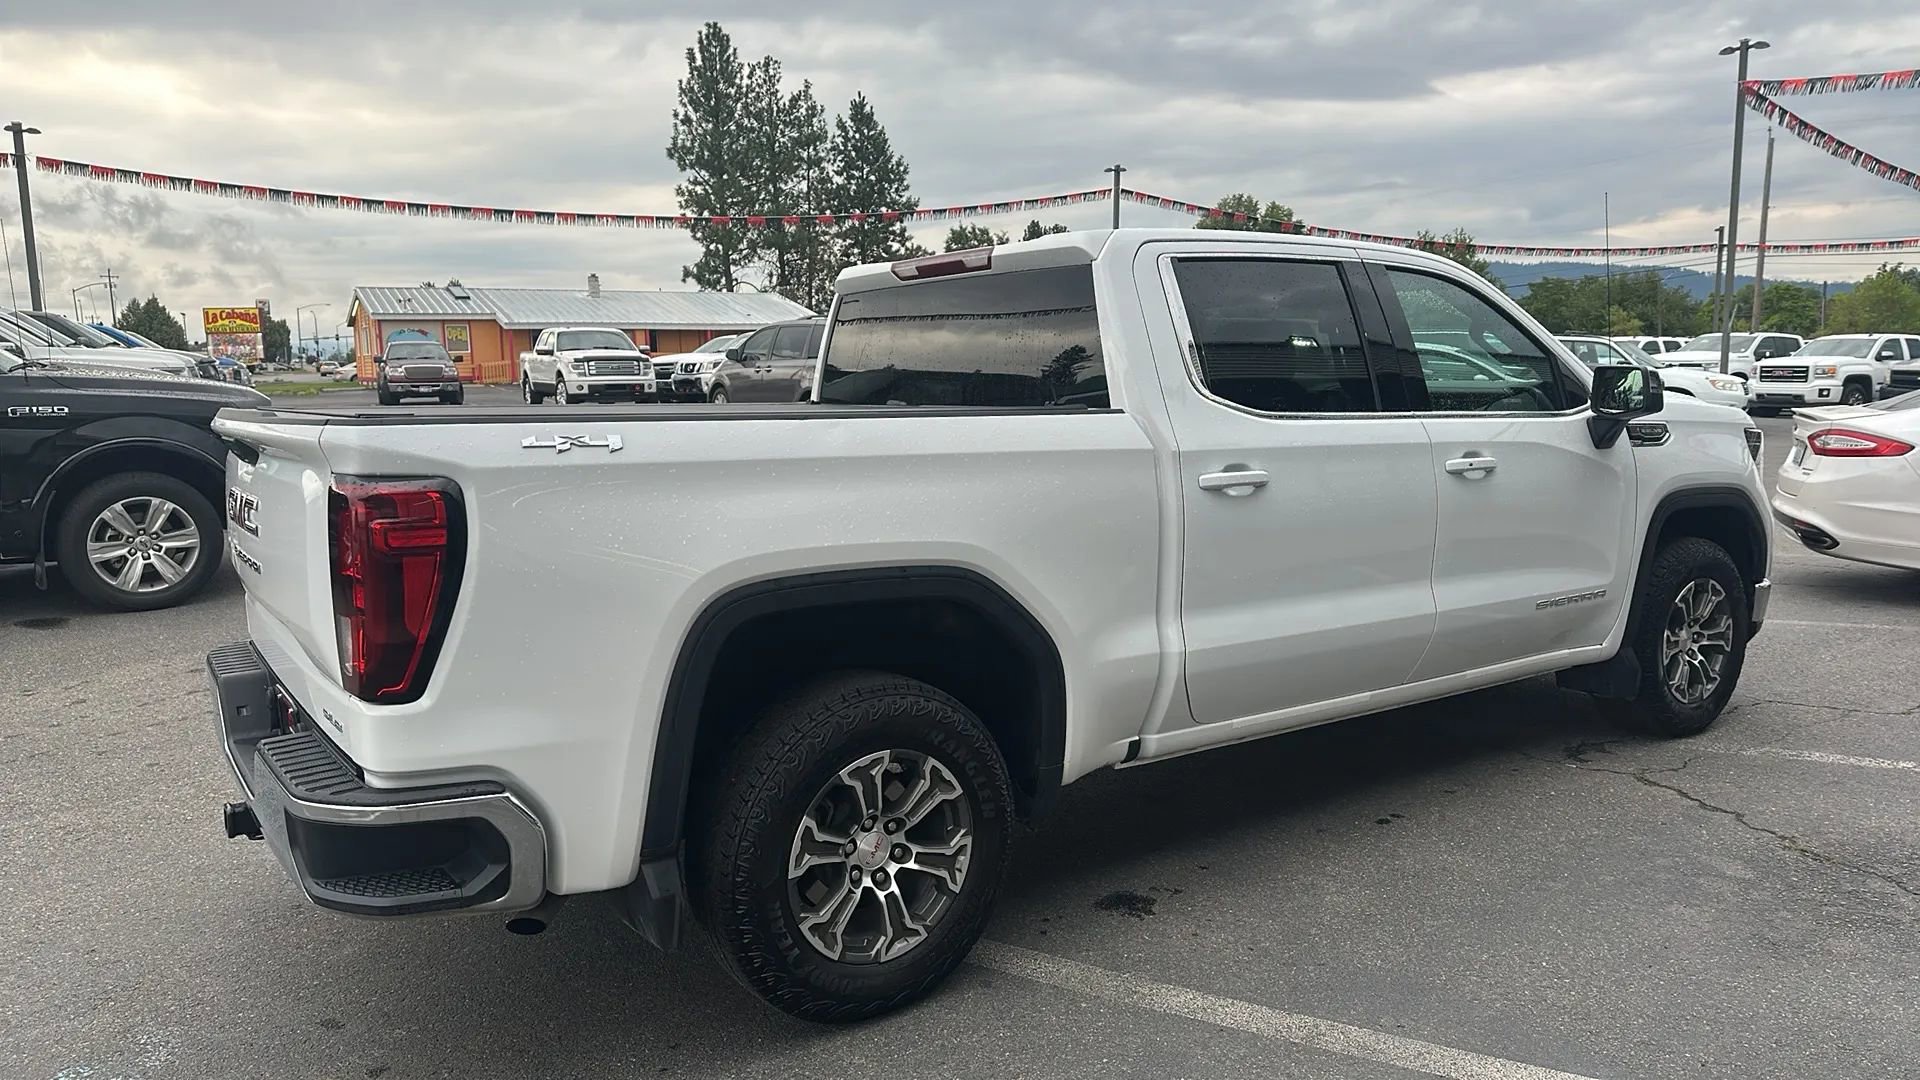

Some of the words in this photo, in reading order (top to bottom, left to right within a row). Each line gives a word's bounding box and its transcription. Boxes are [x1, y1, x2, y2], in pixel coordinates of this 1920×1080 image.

[205, 311, 218, 325] La
[220, 309, 258, 325] Cabaña
[447, 327, 467, 341] OPEN
[1772, 368, 1793, 377] GMC
[1535, 589, 1607, 610] SIERRA
[865, 835, 883, 864] GMC
